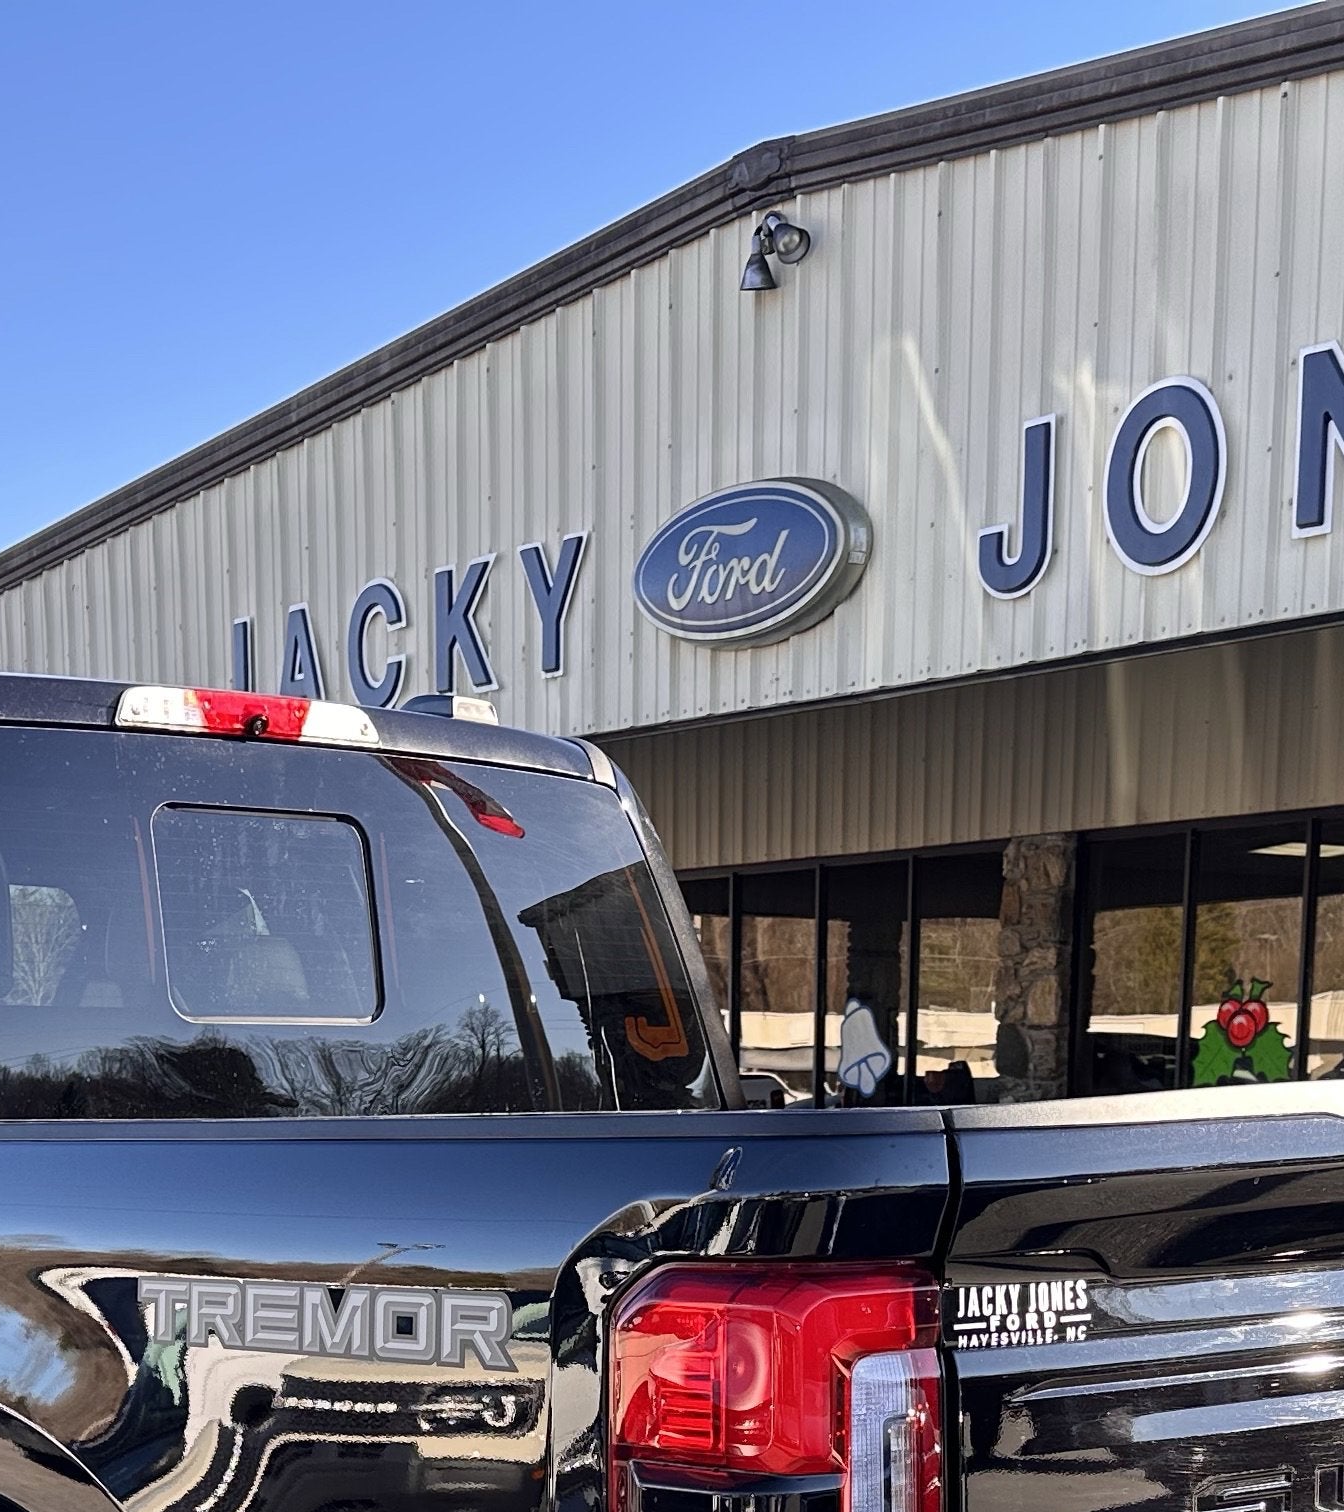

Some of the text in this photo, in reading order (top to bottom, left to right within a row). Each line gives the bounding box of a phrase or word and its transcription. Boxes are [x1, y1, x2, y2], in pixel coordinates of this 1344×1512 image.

[232, 530, 588, 709] JACKY
[667, 516, 787, 609] Ford
[957, 1279, 1088, 1318] JACKY JONES
[138, 1277, 519, 1373] TREMOR
[989, 1311, 1057, 1332] FORD
[1066, 1325, 1088, 1342] NC
